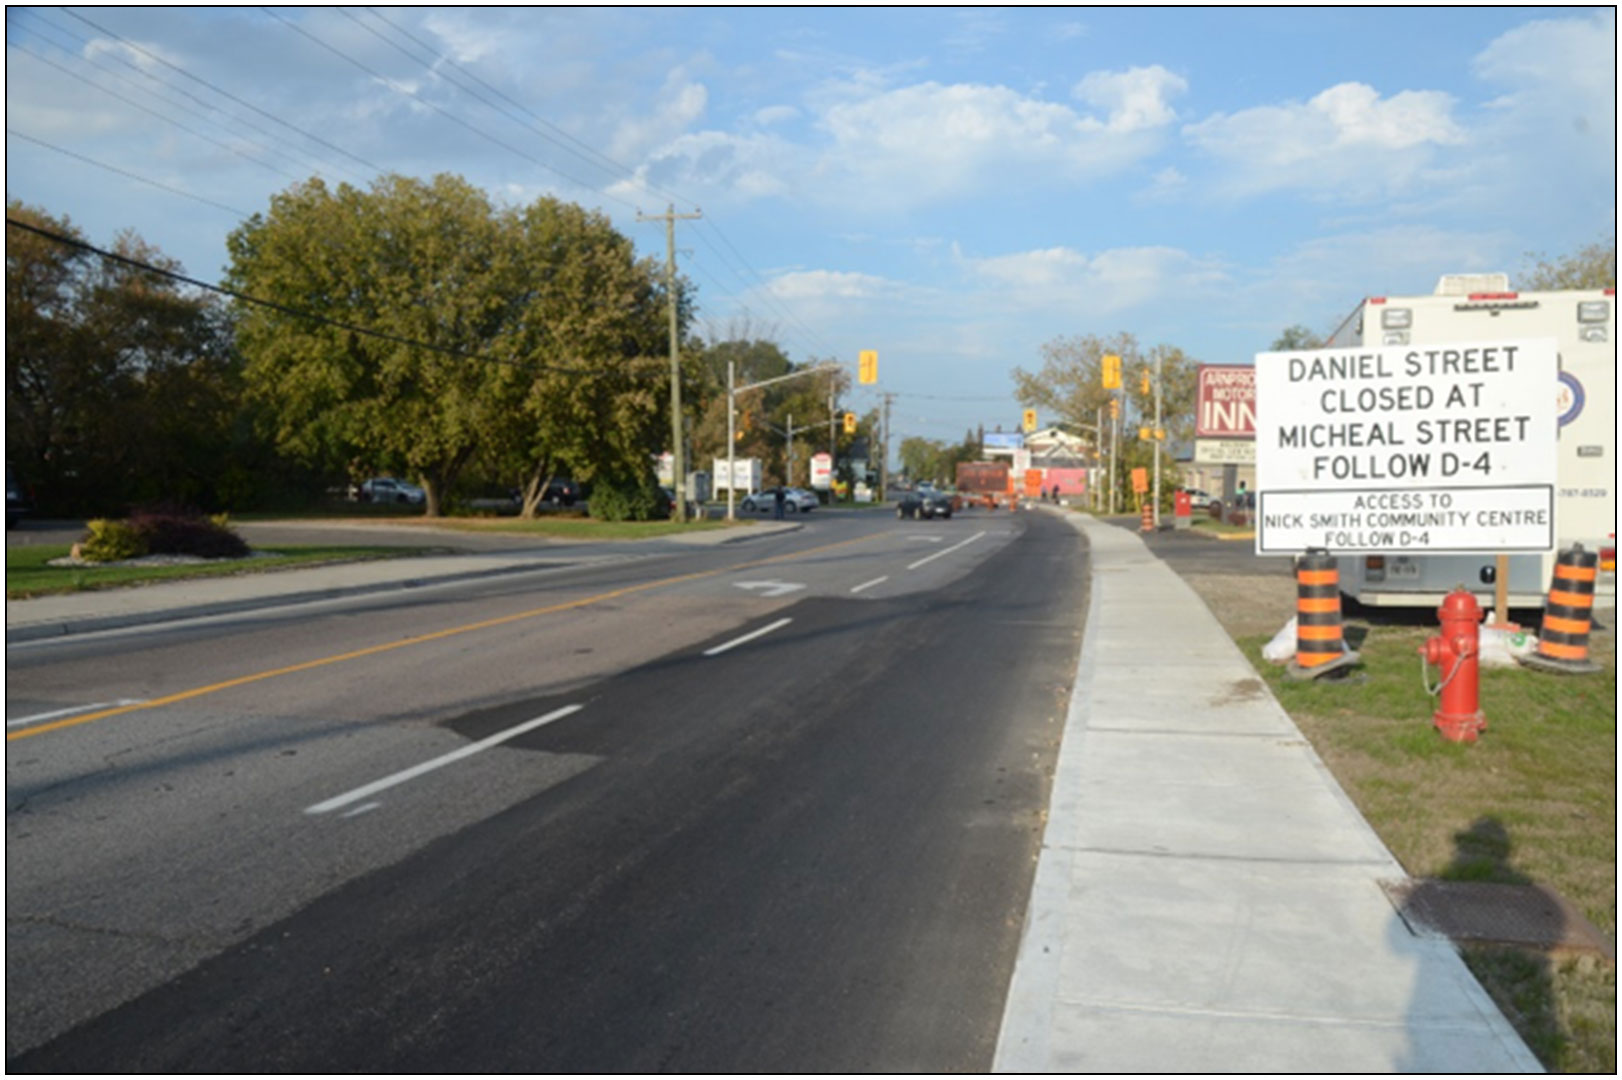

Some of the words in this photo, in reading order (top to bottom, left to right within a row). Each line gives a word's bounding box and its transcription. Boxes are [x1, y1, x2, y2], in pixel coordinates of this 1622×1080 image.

[1288, 354, 1392, 382] DANIEL
[1405, 347, 1518, 377] STREET
[1321, 386, 1433, 413] CLOSED
[1446, 383, 1483, 408] AT
[1204, 401, 1255, 431] INN
[1280, 424, 1404, 448] MICHEAL
[1417, 416, 1530, 445] STREET
[1315, 454, 1430, 479] FOLLOW
[1442, 452, 1491, 476] D-4
[1354, 494, 1423, 510] ACCESS
[1429, 493, 1453, 509] TO
[1265, 514, 1303, 529] NICK
[1310, 513, 1361, 529] SMITH
[1366, 511, 1470, 528] COMMUNITY
[1477, 509, 1547, 527] CENTRE
[1325, 532, 1394, 547] FOLLOW
[1400, 531, 1429, 546] D-4
